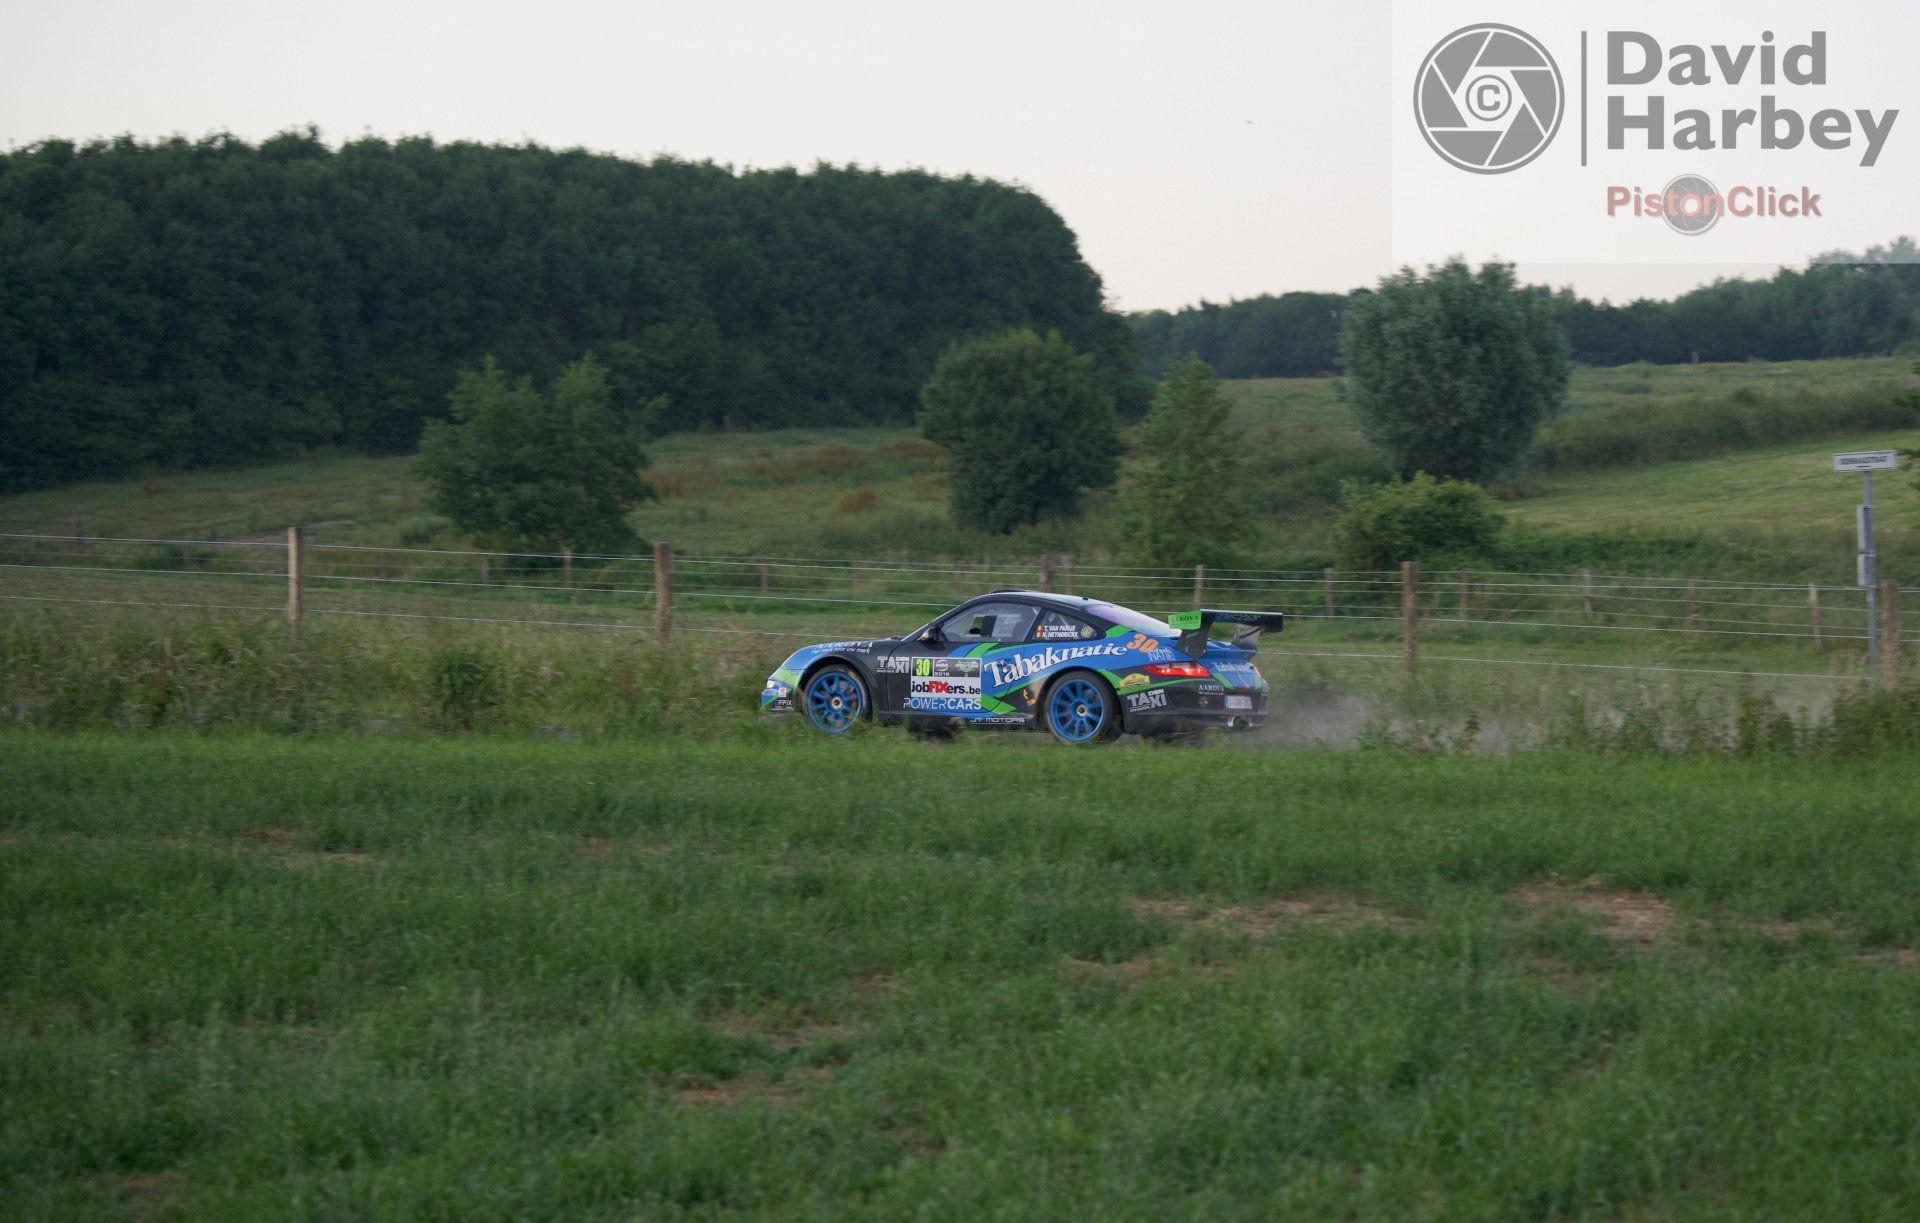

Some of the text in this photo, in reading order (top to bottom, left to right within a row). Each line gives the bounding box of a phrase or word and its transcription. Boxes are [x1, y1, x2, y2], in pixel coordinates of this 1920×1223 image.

[1126, 633, 1159, 653] 30
[915, 658, 930, 676] 30
[983, 643, 1128, 687] Tabaknatie
[911, 680, 981, 695] jobFIXers.be
[903, 697, 982, 710] POWERCARS
[1127, 692, 1167, 708] TAXI
